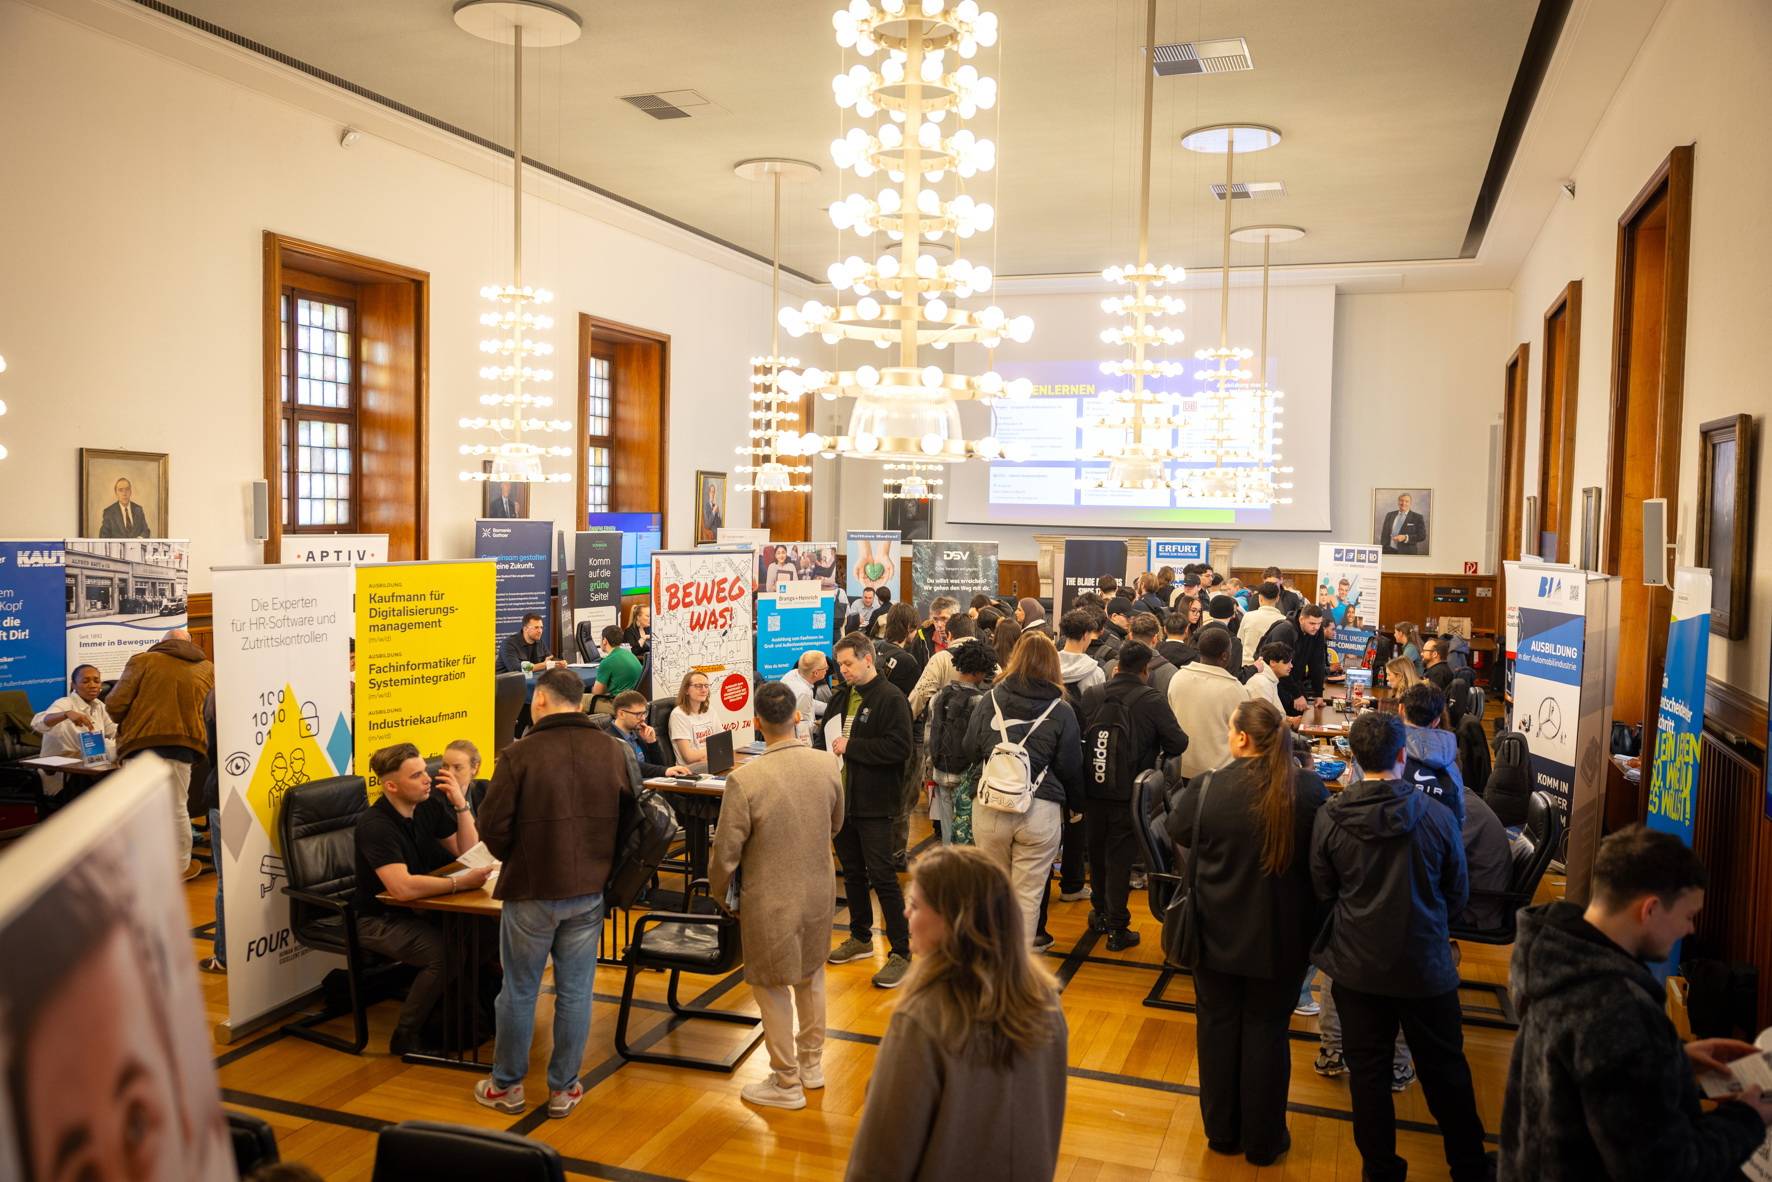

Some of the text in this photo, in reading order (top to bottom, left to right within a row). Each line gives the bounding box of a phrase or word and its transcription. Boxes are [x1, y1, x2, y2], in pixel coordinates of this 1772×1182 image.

[1032, 384, 1096, 395] ENLERNEN
[306, 550, 366, 562] APTIV
[588, 558, 611, 566] Komm
[943, 551, 970, 560] DSV
[588, 569, 611, 578] auf die
[590, 581, 609, 592] grüne
[1066, 577, 1076, 586] THE
[1077, 577, 1095, 586] BLADE
[368, 590, 446, 604] Kaufmann für
[665, 576, 745, 612] BEWEG
[251, 597, 317, 612] Die Experten
[368, 605, 459, 620] Digitalisierungs-
[690, 607, 733, 632] WAS!
[2, 616, 21, 627] die
[231, 611, 336, 632] für HR-Software und
[368, 618, 442, 632] management
[9, 629, 30, 640] Dir!
[241, 631, 328, 651] Zutrittskontrollen
[1349, 635, 1369, 643] UNSER
[79, 640, 106, 648] Immer
[1531, 640, 1578, 658] AUSBILDUNG
[368, 654, 477, 675] Fachinformatiker für
[1531, 656, 1577, 670] Automobilindustrie
[368, 670, 466, 690] Systemintegration
[252, 708, 286, 727] 1010
[368, 710, 468, 731] Industriekaufmann
[1093, 730, 1109, 783] adidas
[1537, 772, 1569, 794] KOMM IN
[246, 928, 290, 962] FOUR
